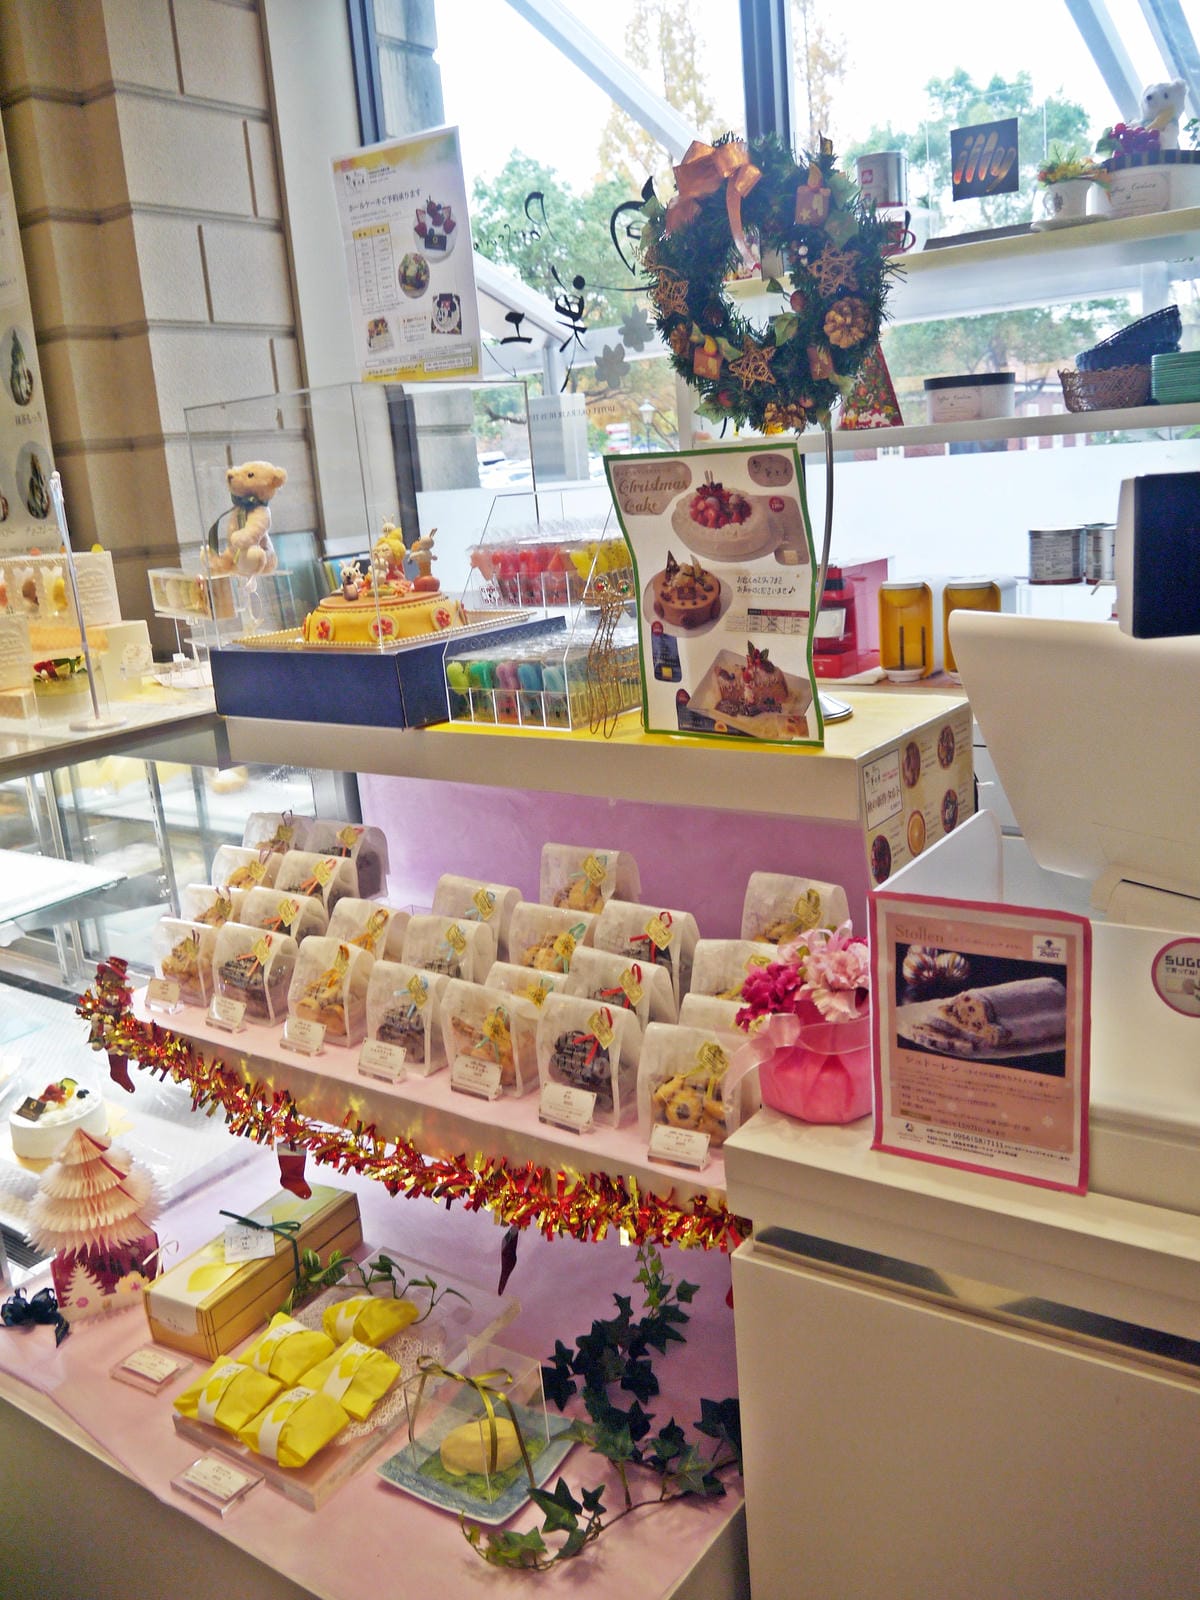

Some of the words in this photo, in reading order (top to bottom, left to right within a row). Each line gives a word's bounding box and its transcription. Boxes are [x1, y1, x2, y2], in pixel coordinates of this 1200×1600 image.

[952, 131, 1017, 192] illy
[618, 475, 688, 497] Christmas
[624, 495, 660, 513] Cake
[895, 924, 945, 943] Stollen
